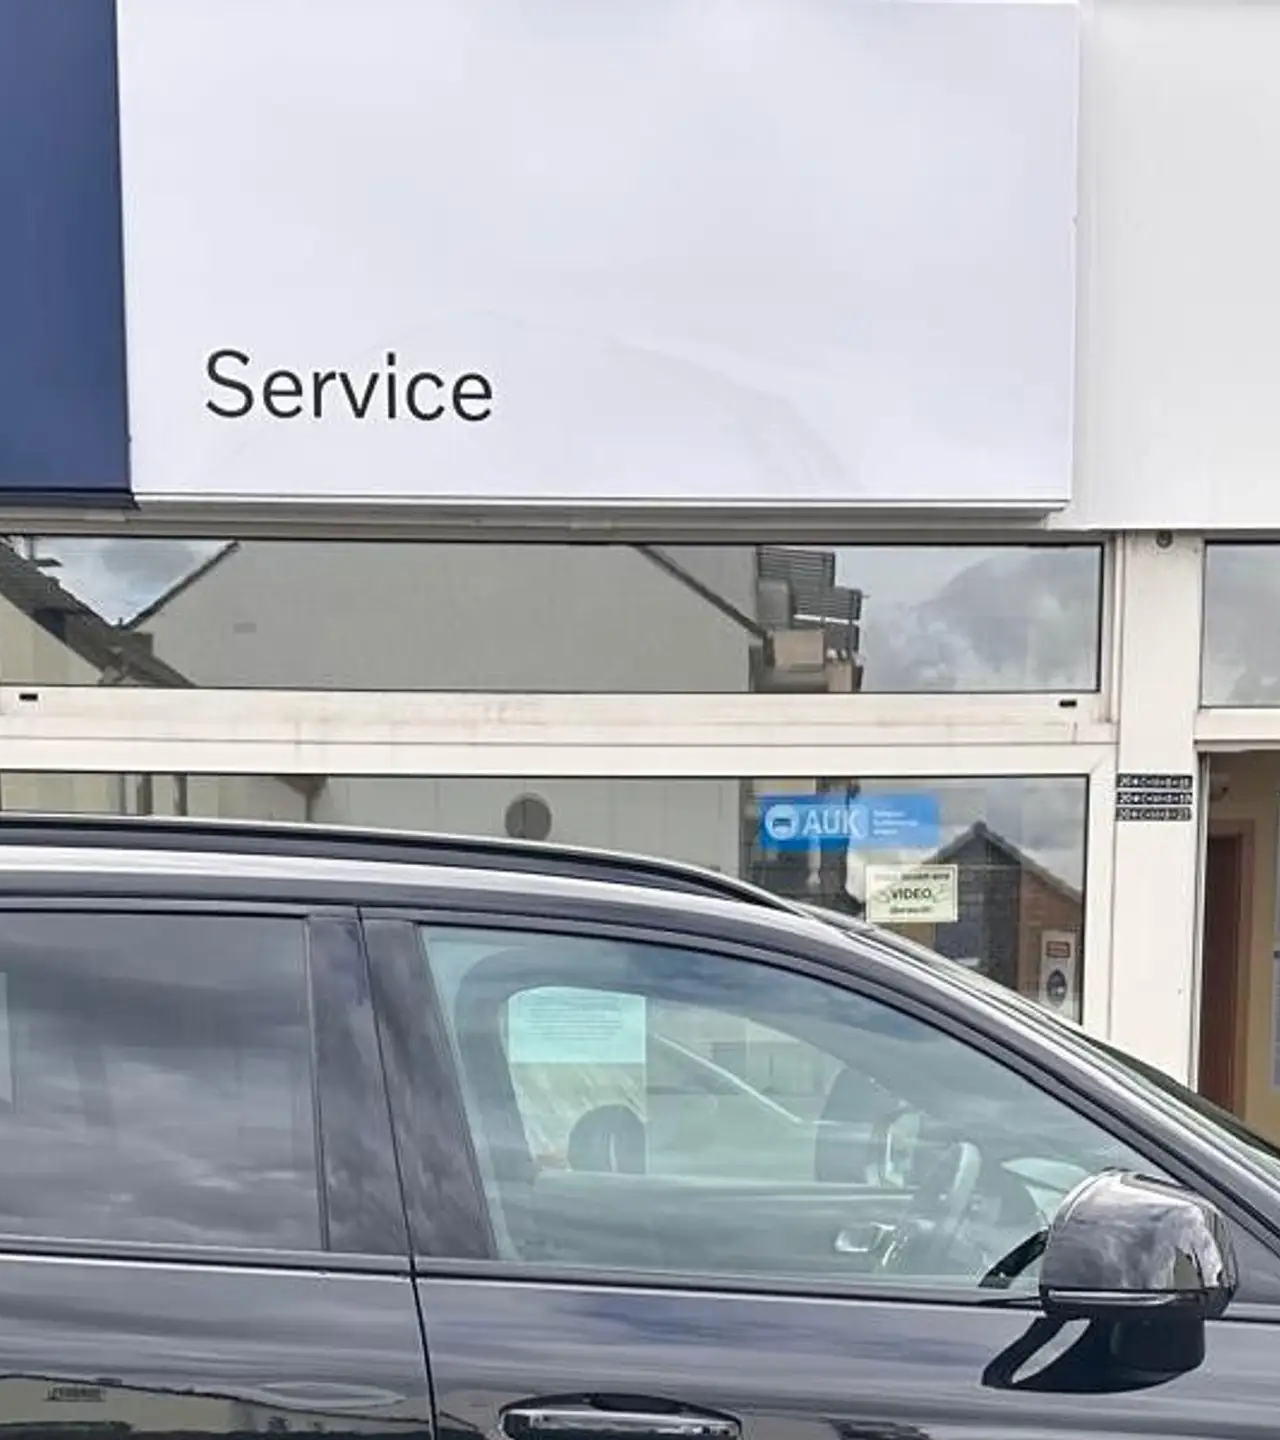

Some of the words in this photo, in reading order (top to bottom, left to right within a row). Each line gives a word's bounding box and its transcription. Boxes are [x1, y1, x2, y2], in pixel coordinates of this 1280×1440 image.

[205, 347, 493, 422] Service
[801, 807, 862, 839] AUK
[891, 887, 932, 900] VIDEO
